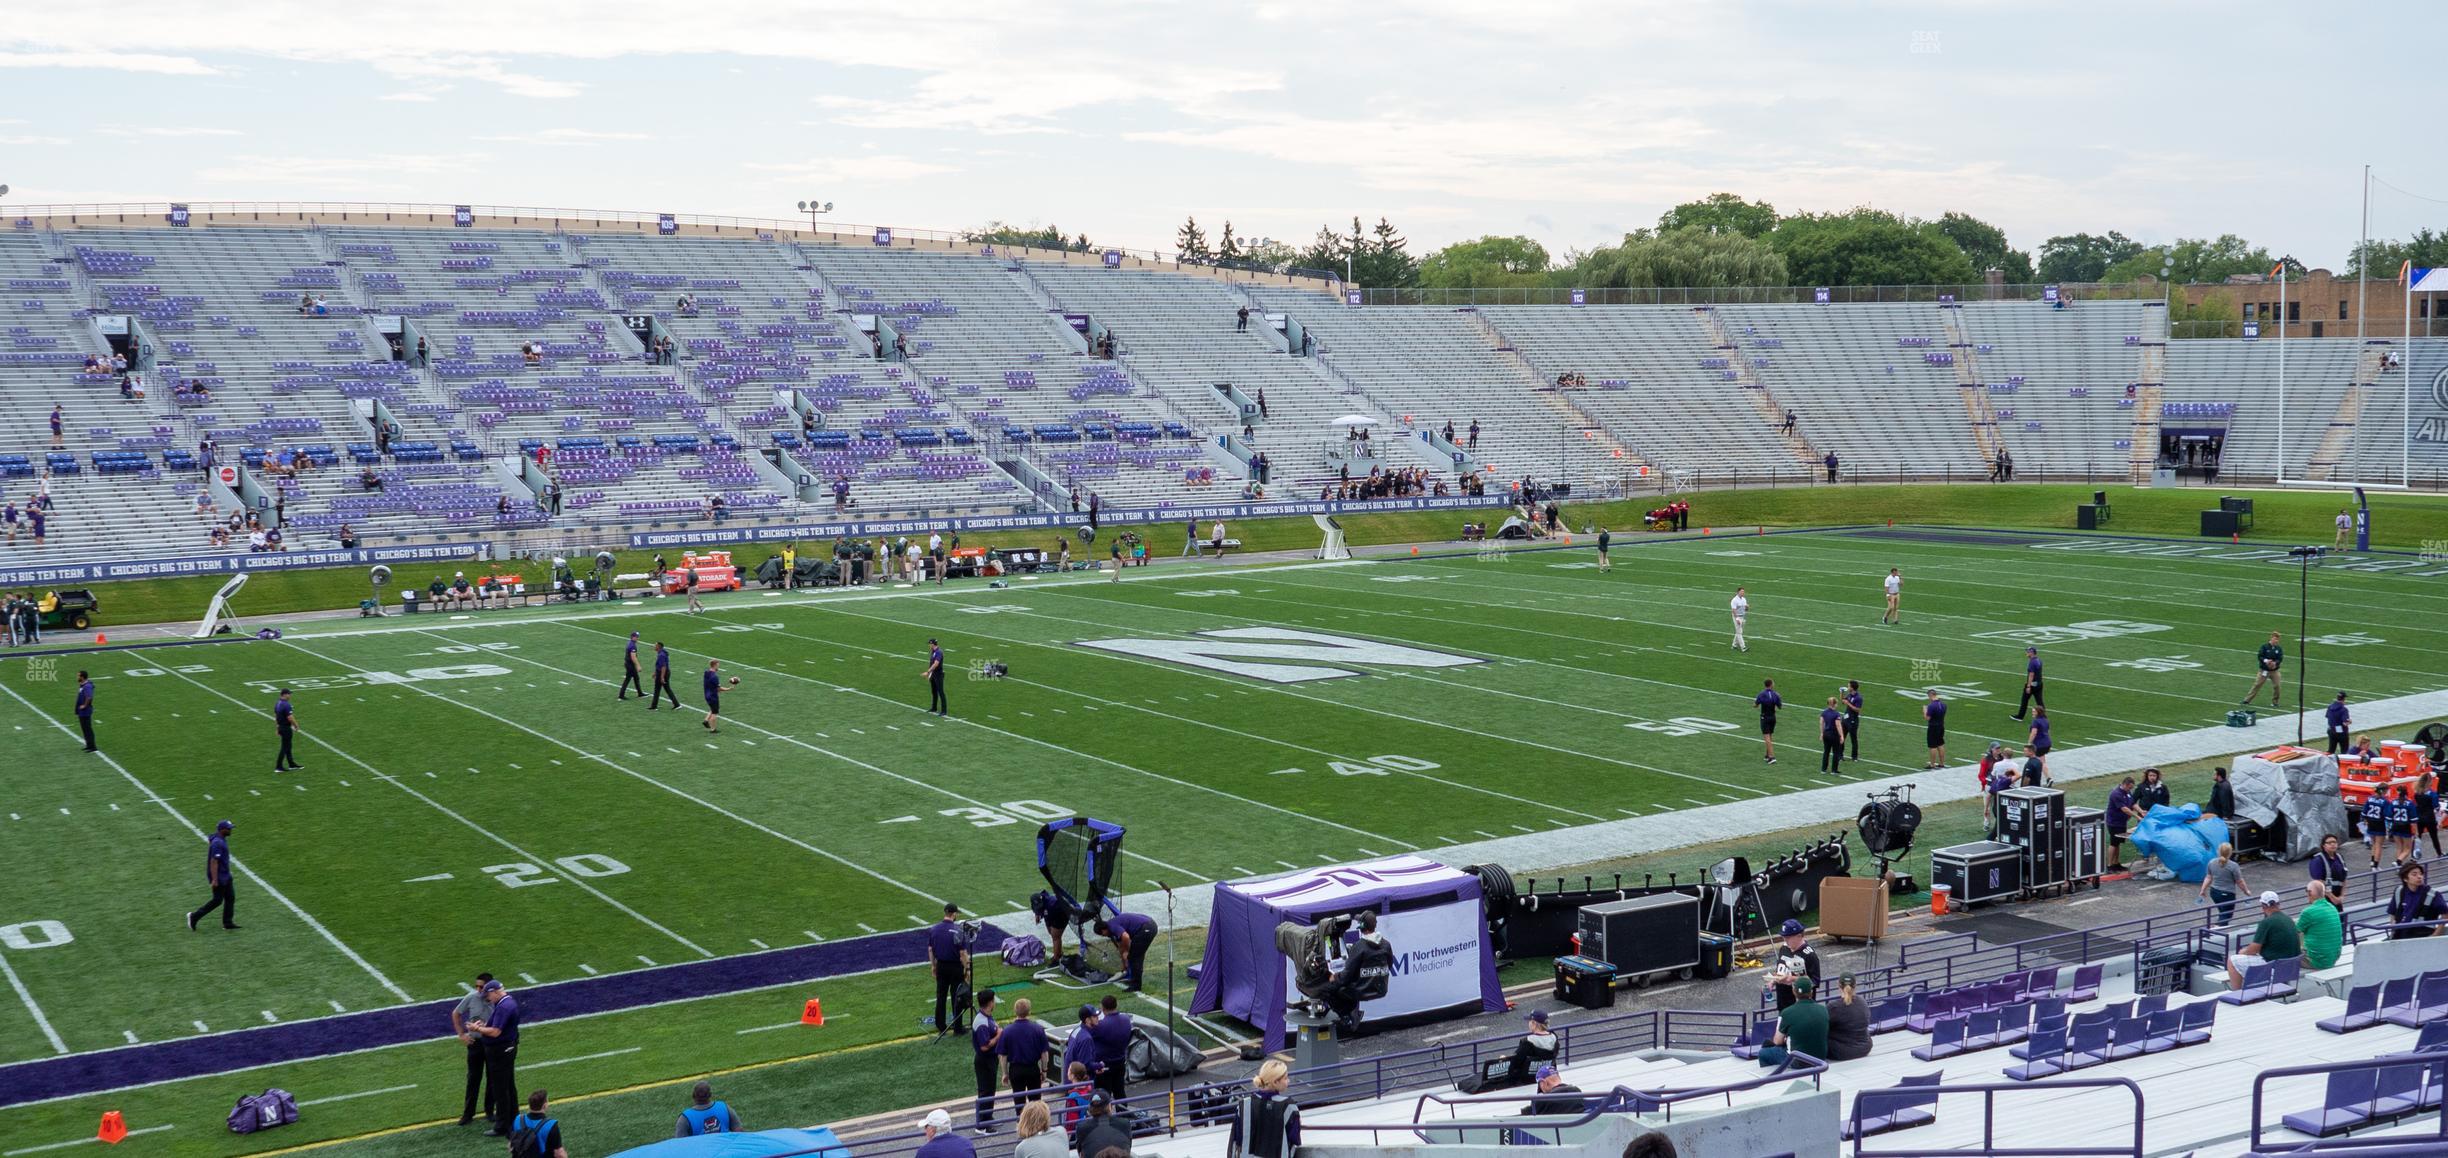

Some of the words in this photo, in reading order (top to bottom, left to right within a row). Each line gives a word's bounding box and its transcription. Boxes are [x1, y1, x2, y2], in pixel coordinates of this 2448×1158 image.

[173, 211, 187, 220] 107
[457, 212, 470, 221] 108
[661, 219, 674, 229] 109
[879, 233, 889, 242] 110
[1108, 255, 1118, 263] 111
[1350, 294, 1360, 303] 112
[1574, 294, 1584, 303] 113
[1817, 292, 1828, 301] 114
[2046, 290, 2057, 299] 115
[2244, 327, 2257, 336] 116
[648, 535, 686, 544] CHICAGO'S
[688, 533, 700, 542] BIG
[702, 533, 717, 542] TEN
[718, 531, 738, 540] TEAM
[759, 528, 796, 538] CHICAGO'S
[811, 527, 825, 536] TEN
[826, 525, 845, 535] TEAM
[865, 523, 900, 533] CHICAGO'S
[902, 522, 913, 531] BIG
[914, 521, 928, 530] TEN
[929, 520, 948, 529] TEAM
[967, 519, 1001, 528] CHICAGO'S
[1003, 518, 1013, 526] BIG
[1015, 517, 1028, 526] TEN
[1029, 516, 1047, 525] TEAM
[1100, 512, 1110, 521] BIG
[1111, 512, 1124, 521] TEN
[1125, 511, 1143, 520] TEAM
[1161, 509, 1192, 519] CHICAGO'S
[1193, 508, 1203, 517] BIG
[1205, 508, 1217, 517] TEN
[1218, 507, 1235, 516] TEAM
[1252, 505, 1283, 515] CHICAGO'S
[1285, 504, 1295, 513] BIG
[1296, 504, 1308, 513] TEN
[1309, 504, 1325, 512] TEAM
[1342, 501, 1372, 511] CHICAGO'S
[1373, 501, 1383, 509] BIG
[1384, 501, 1395, 509] TEN
[1396, 500, 1413, 508] TEAM
[1429, 498, 1458, 507] CHICAGO'S
[1459, 497, 1469, 506] BIG
[1470, 497, 1481, 505] TEN
[1482, 496, 1498, 505] TEAM
[18, 571, 35, 582] BIG
[38, 570, 55, 580] TEN
[58, 568, 84, 579] TEAM
[110, 563, 158, 575] CHICAGO'S
[160, 562, 175, 572] BIG
[178, 561, 195, 571] TEN
[197, 560, 222, 570] TEAM
[246, 556, 291, 567] CHICAGO'S
[293, 555, 307, 565] BIG
[309, 554, 326, 564] TEN
[328, 552, 352, 562] TEAM
[375, 549, 417, 560] CHICAGO'S
[419, 548, 432, 557] BIG
[434, 547, 450, 556] TEN
[452, 546, 475, 555] TEAM
[697, 574, 727, 583] ATORADE
[1623, 717, 1741, 737] 50
[1326, 754, 1441, 777] 40
[937, 799, 1077, 828] 30
[2367, 804, 2381, 819] 23
[2393, 807, 2408, 822] 23
[479, 853, 632, 888] 20
[1412, 939, 1477, 961] Northwestern
[1412, 957, 1454, 974] Medicine
[807, 1006, 817, 1018] 20
[264, 1105, 277, 1121] N
